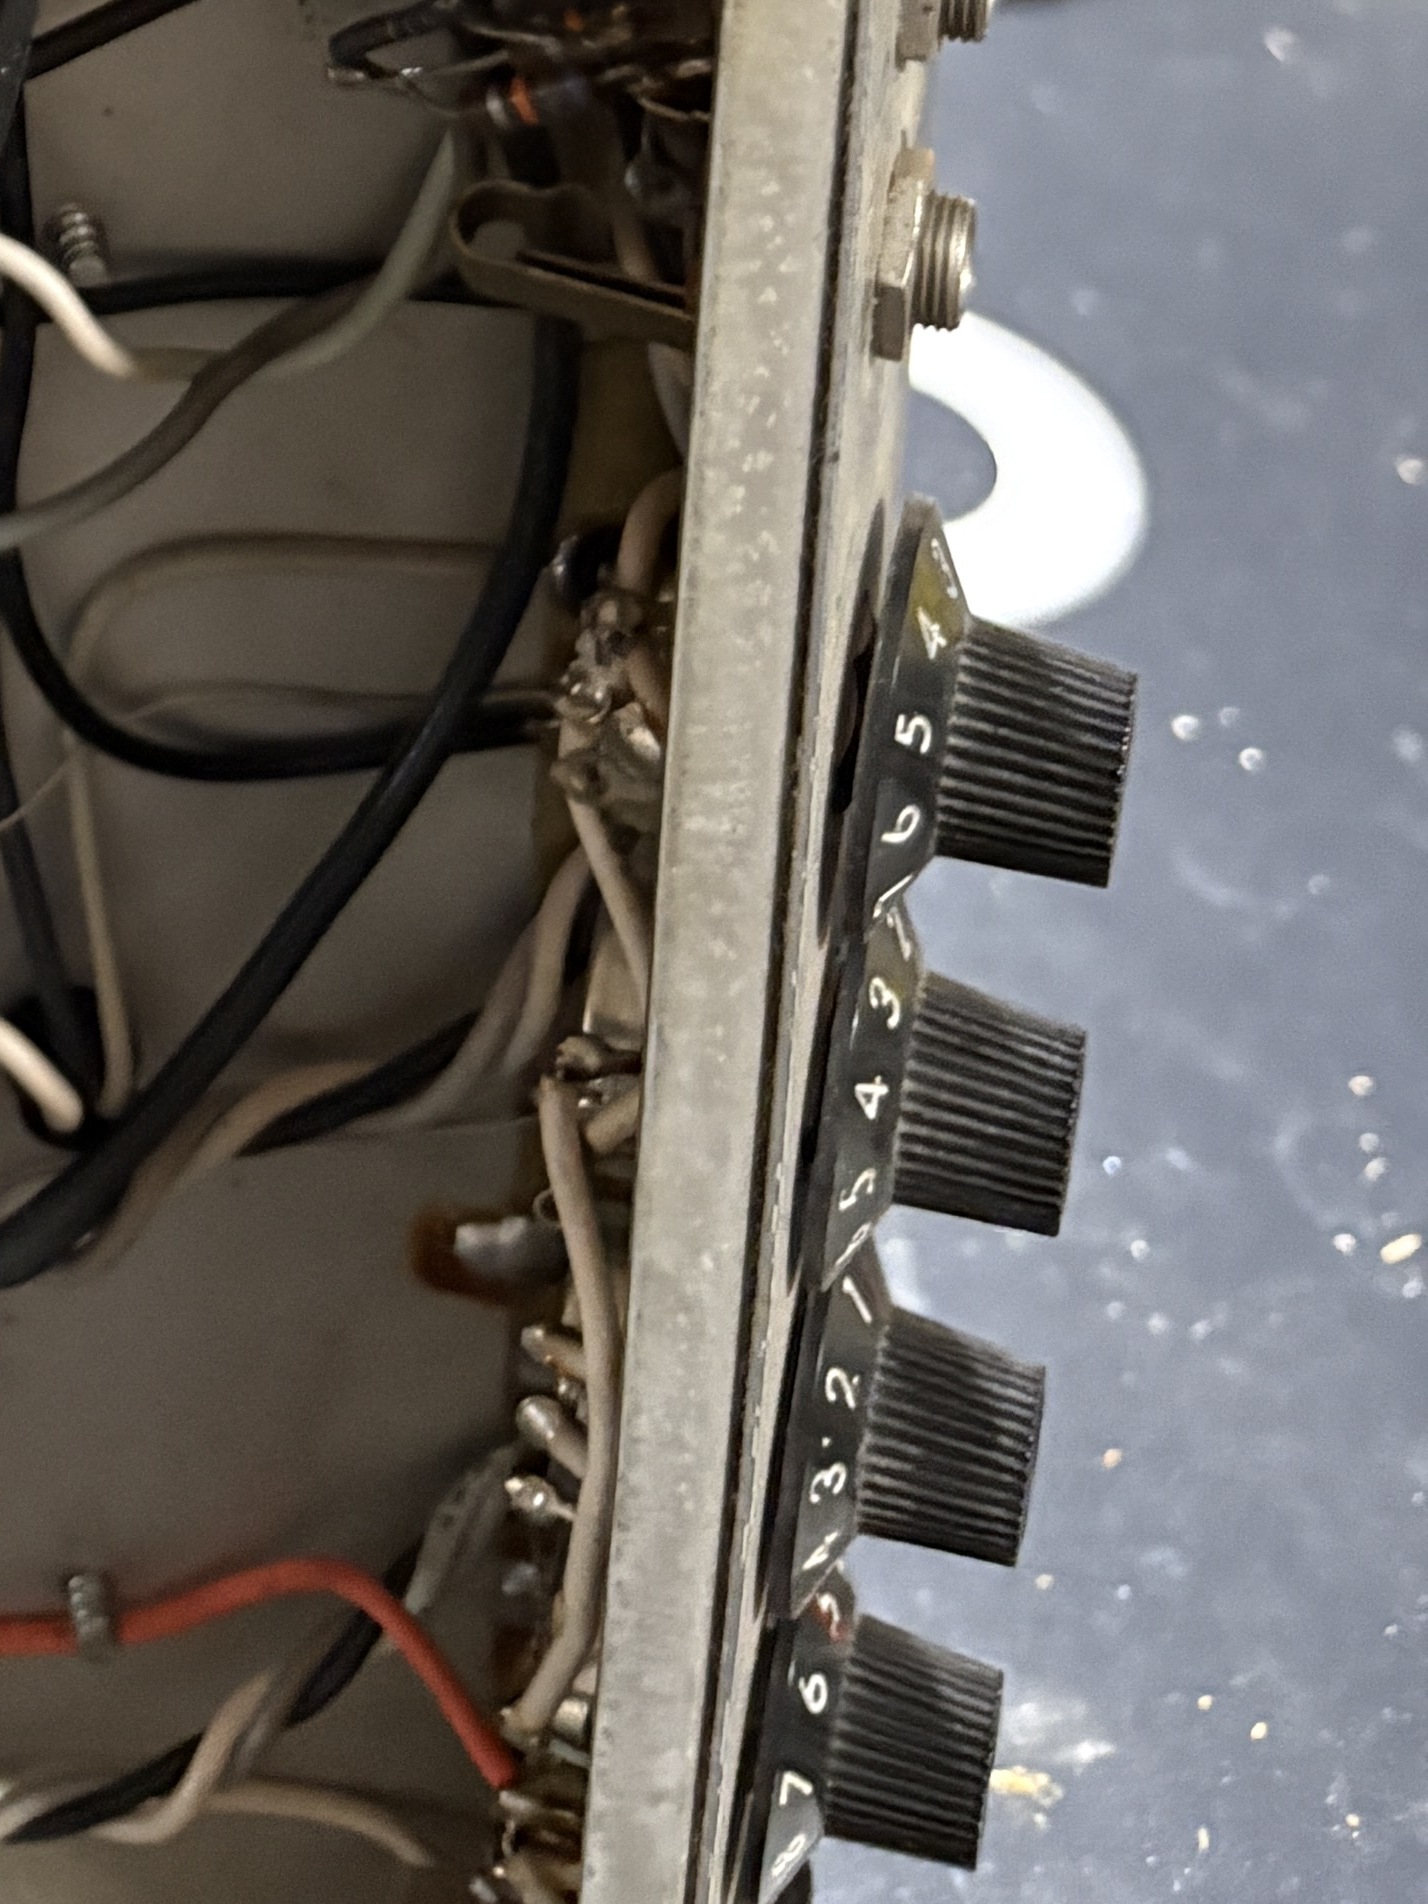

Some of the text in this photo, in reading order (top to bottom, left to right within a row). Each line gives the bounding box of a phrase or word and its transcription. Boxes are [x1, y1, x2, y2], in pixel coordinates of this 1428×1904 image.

[916, 604, 948, 660] 4
[894, 712, 934, 755] 5
[880, 804, 921, 844] 6
[868, 976, 901, 1030] 3
[854, 1074, 890, 1120] 4
[838, 1168, 876, 1211] 5
[842, 1275, 873, 1325] 1
[824, 1367, 861, 1411] 2
[808, 1462, 848, 1505] 3
[798, 1672, 828, 1715] 6
[778, 1770, 814, 1806] 7
